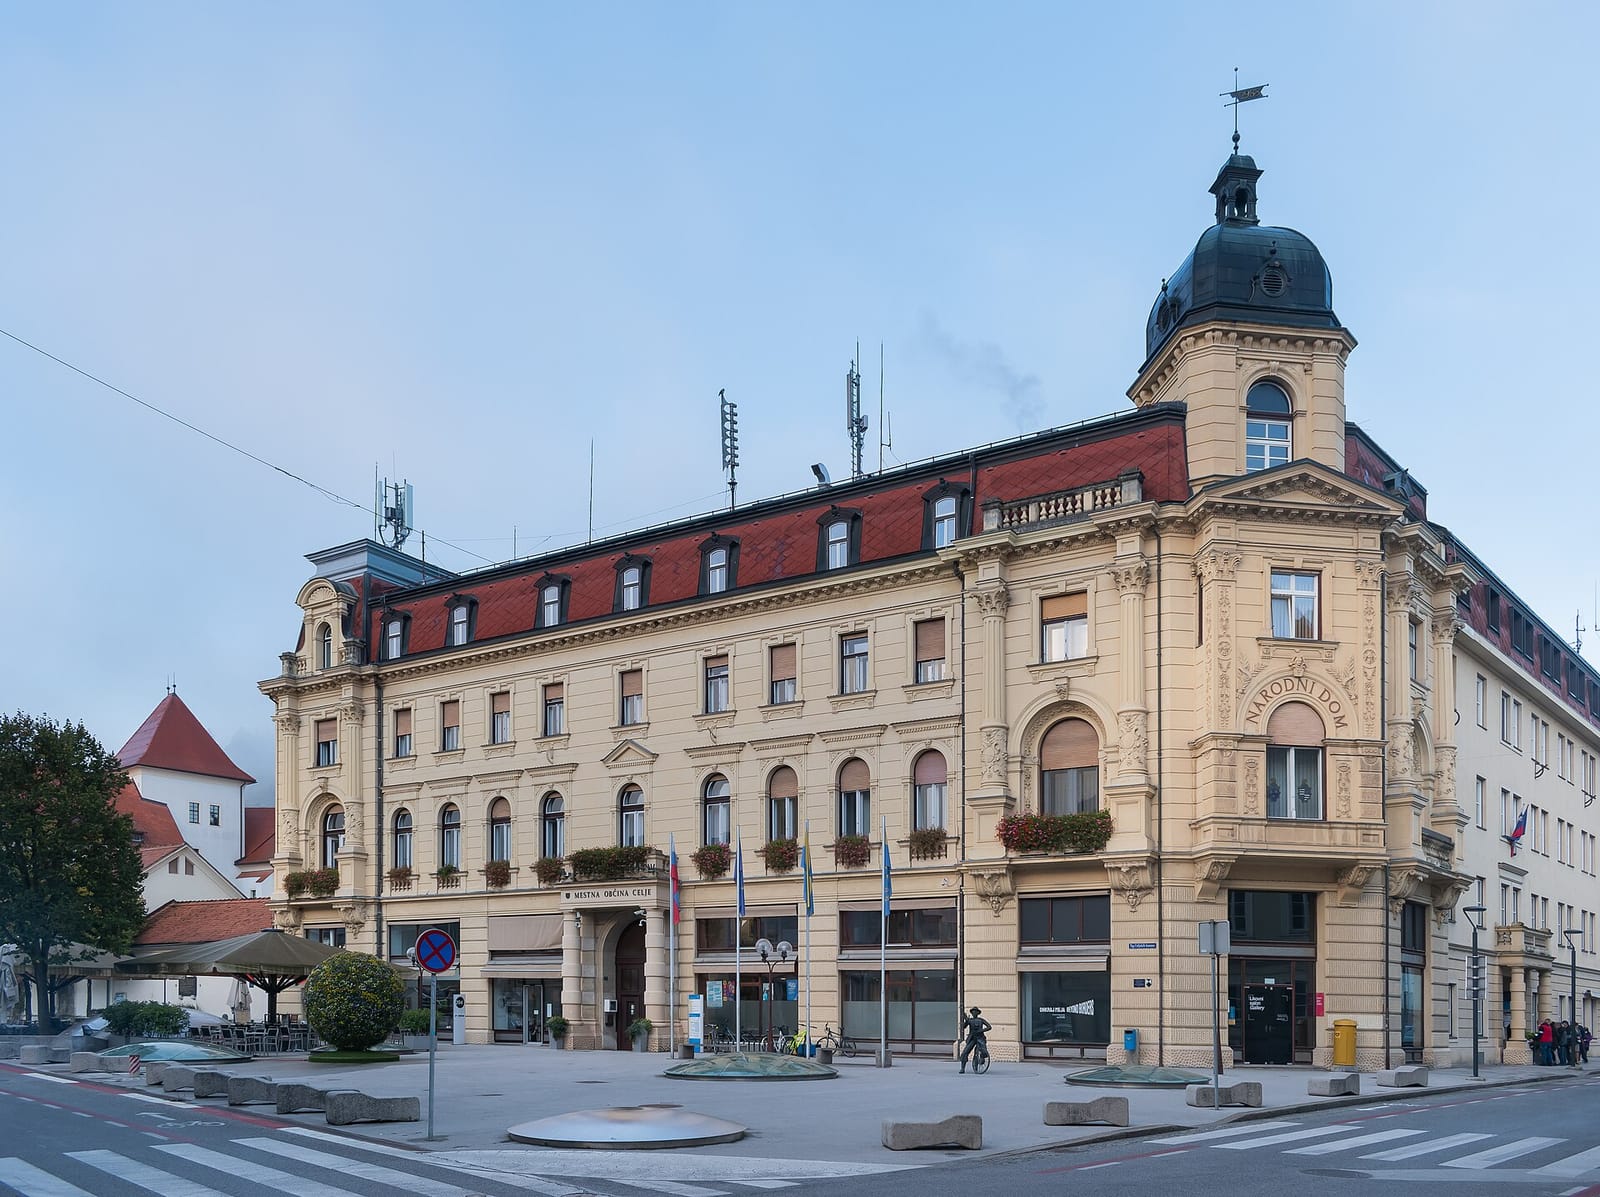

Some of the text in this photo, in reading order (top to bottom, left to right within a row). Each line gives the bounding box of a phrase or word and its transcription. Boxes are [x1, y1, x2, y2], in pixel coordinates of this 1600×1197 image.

[1246, 678, 1348, 729] NARODNI DOM
[574, 888, 651, 899] MESTNA OBČINA CELJE
